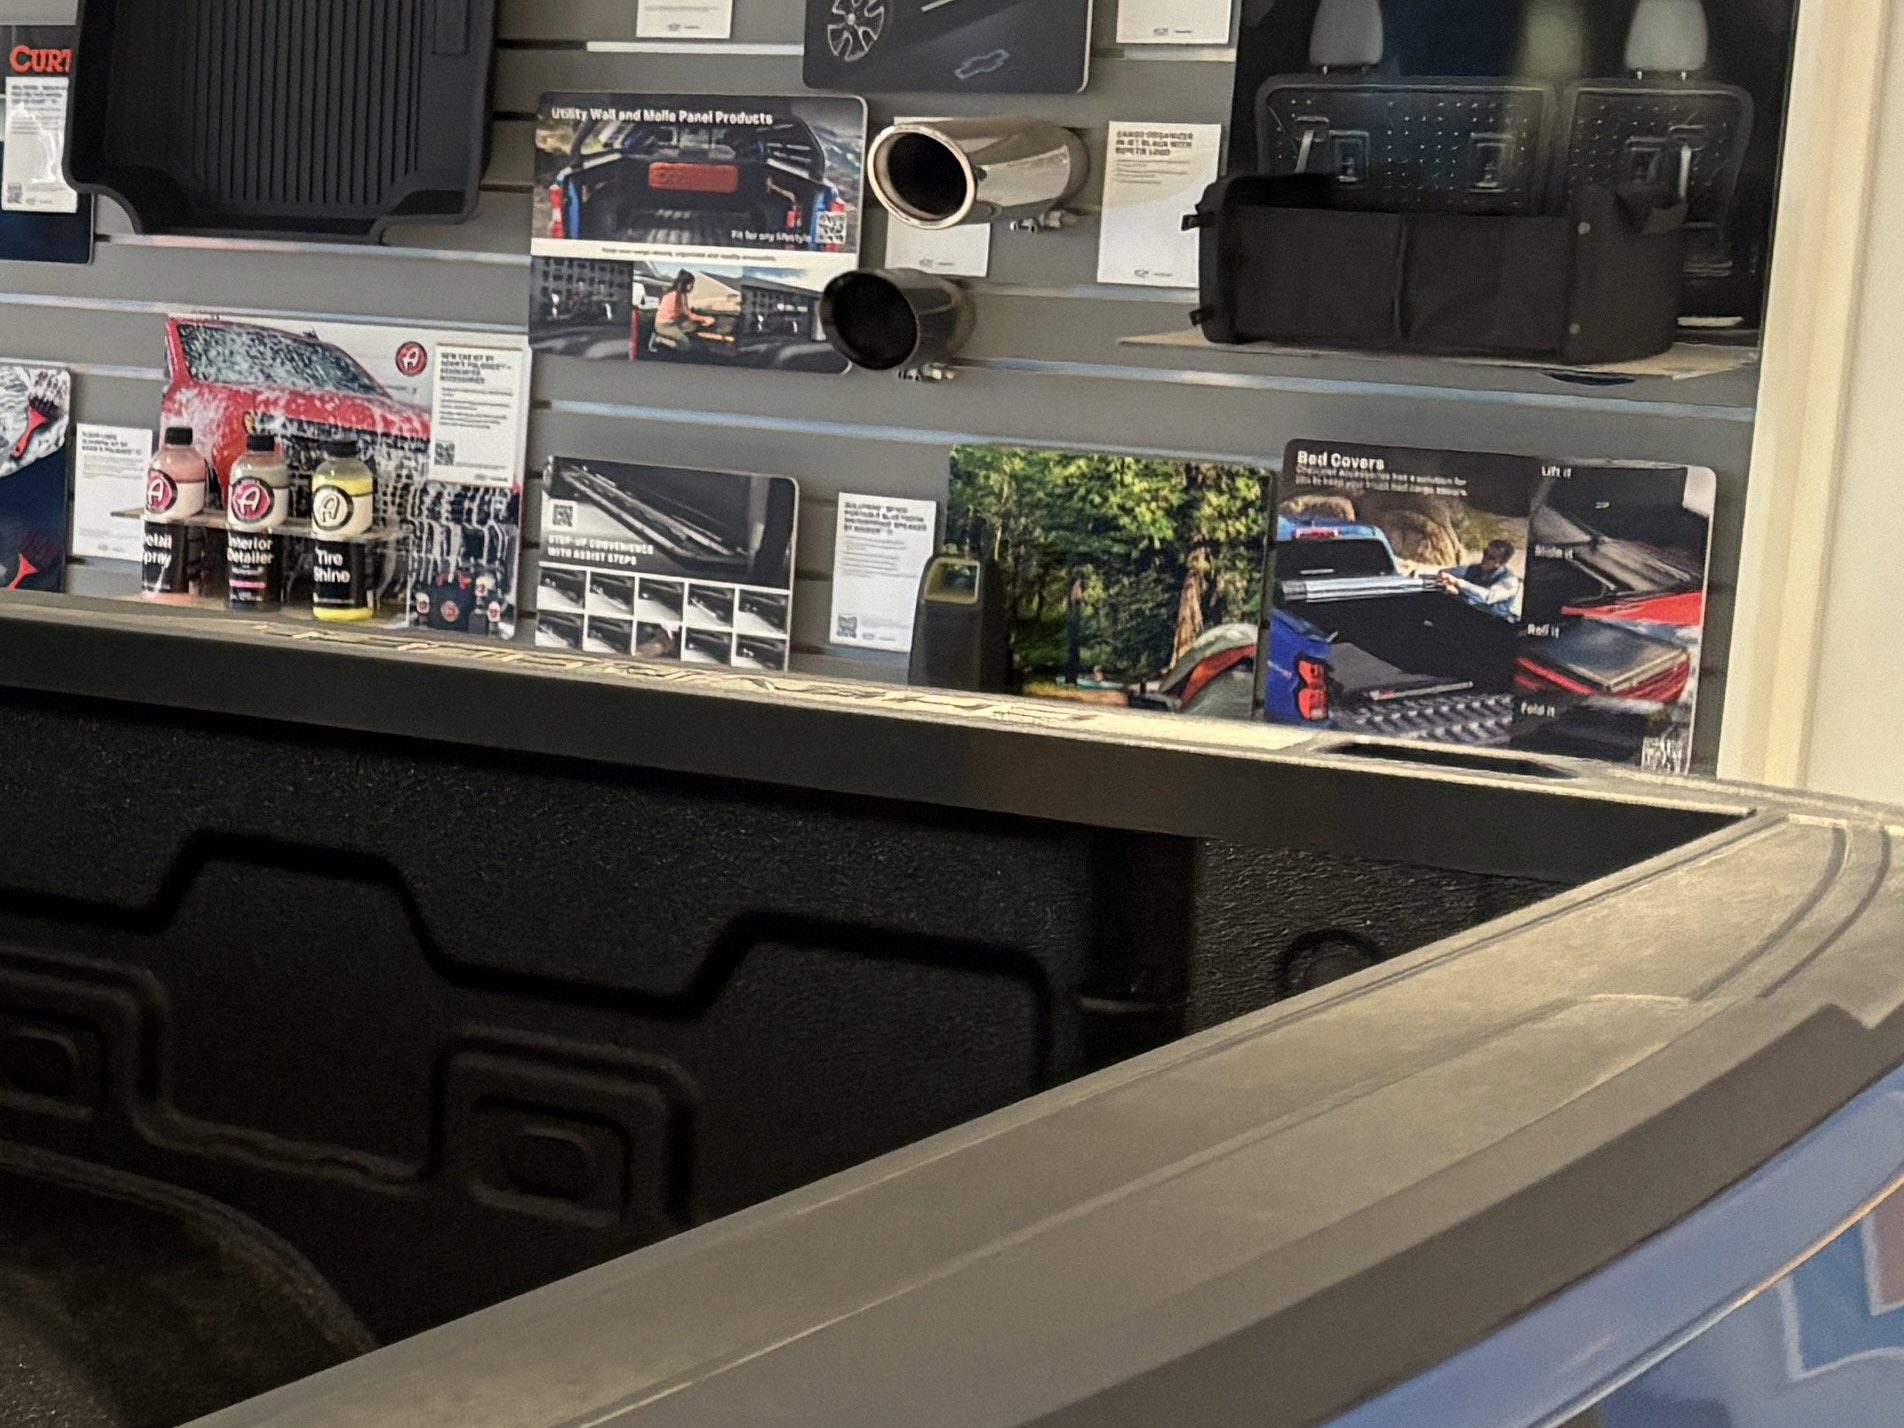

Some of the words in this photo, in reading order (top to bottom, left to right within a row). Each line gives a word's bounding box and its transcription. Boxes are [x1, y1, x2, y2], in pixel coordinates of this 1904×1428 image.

[9, 44, 73, 74] CURT
[551, 107, 588, 121] Utility
[590, 107, 616, 120] Wall
[618, 108, 641, 121] and
[643, 109, 676, 122] Molle
[679, 110, 713, 123] Panel
[715, 110, 774, 125] Products
[1297, 450, 1328, 466] Bed
[1330, 453, 1385, 470] Covers
[228, 534, 274, 551] Interior
[143, 550, 173, 569] pray
[226, 547, 275, 565] Detailer
[318, 552, 344, 567] Tire
[313, 567, 352, 584] Shine
